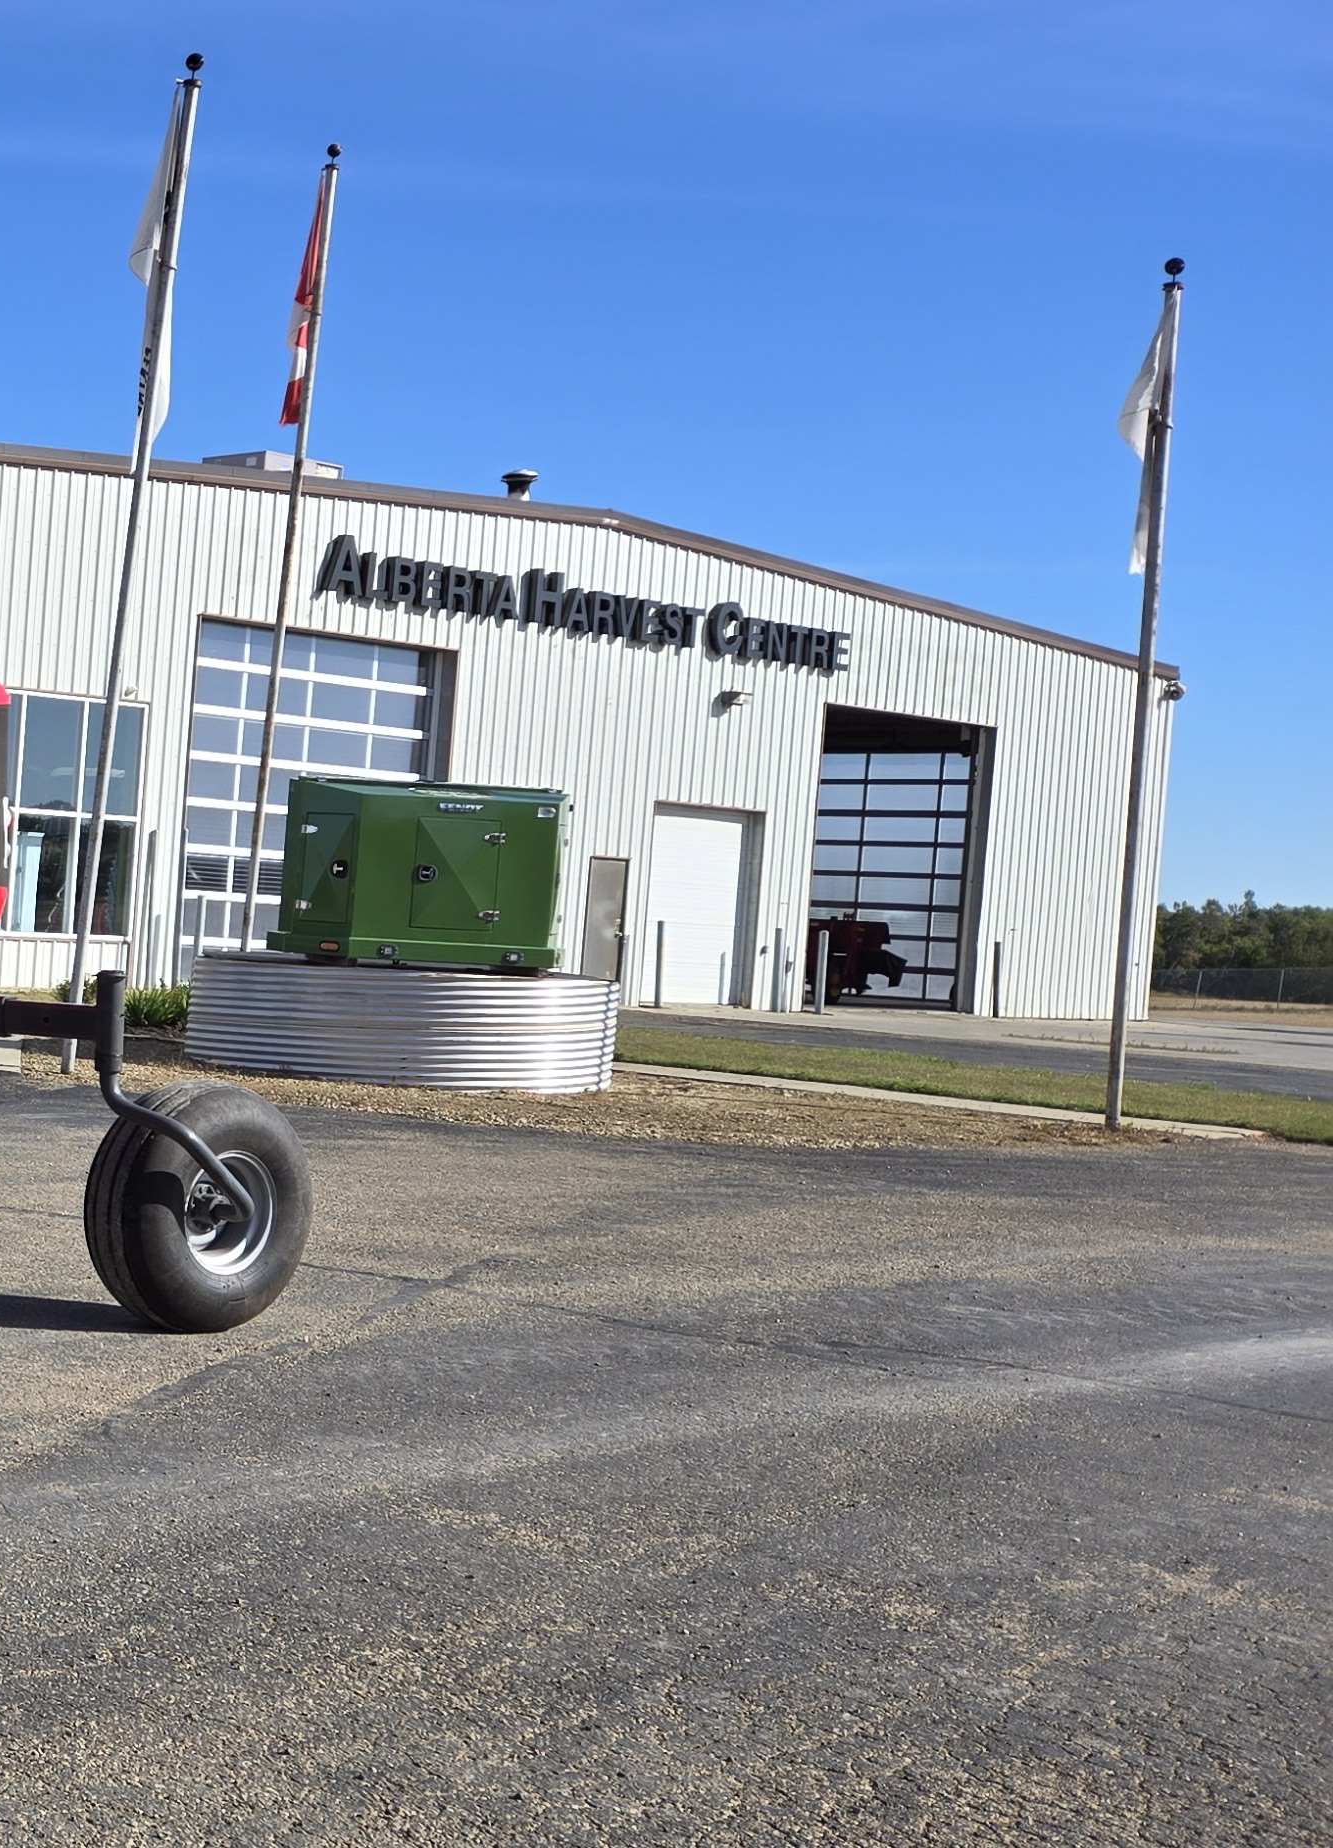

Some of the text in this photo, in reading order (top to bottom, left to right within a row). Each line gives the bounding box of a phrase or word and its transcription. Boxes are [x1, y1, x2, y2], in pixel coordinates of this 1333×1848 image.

[326, 535, 851, 671] ALBERTA HARVEST CENTRE
